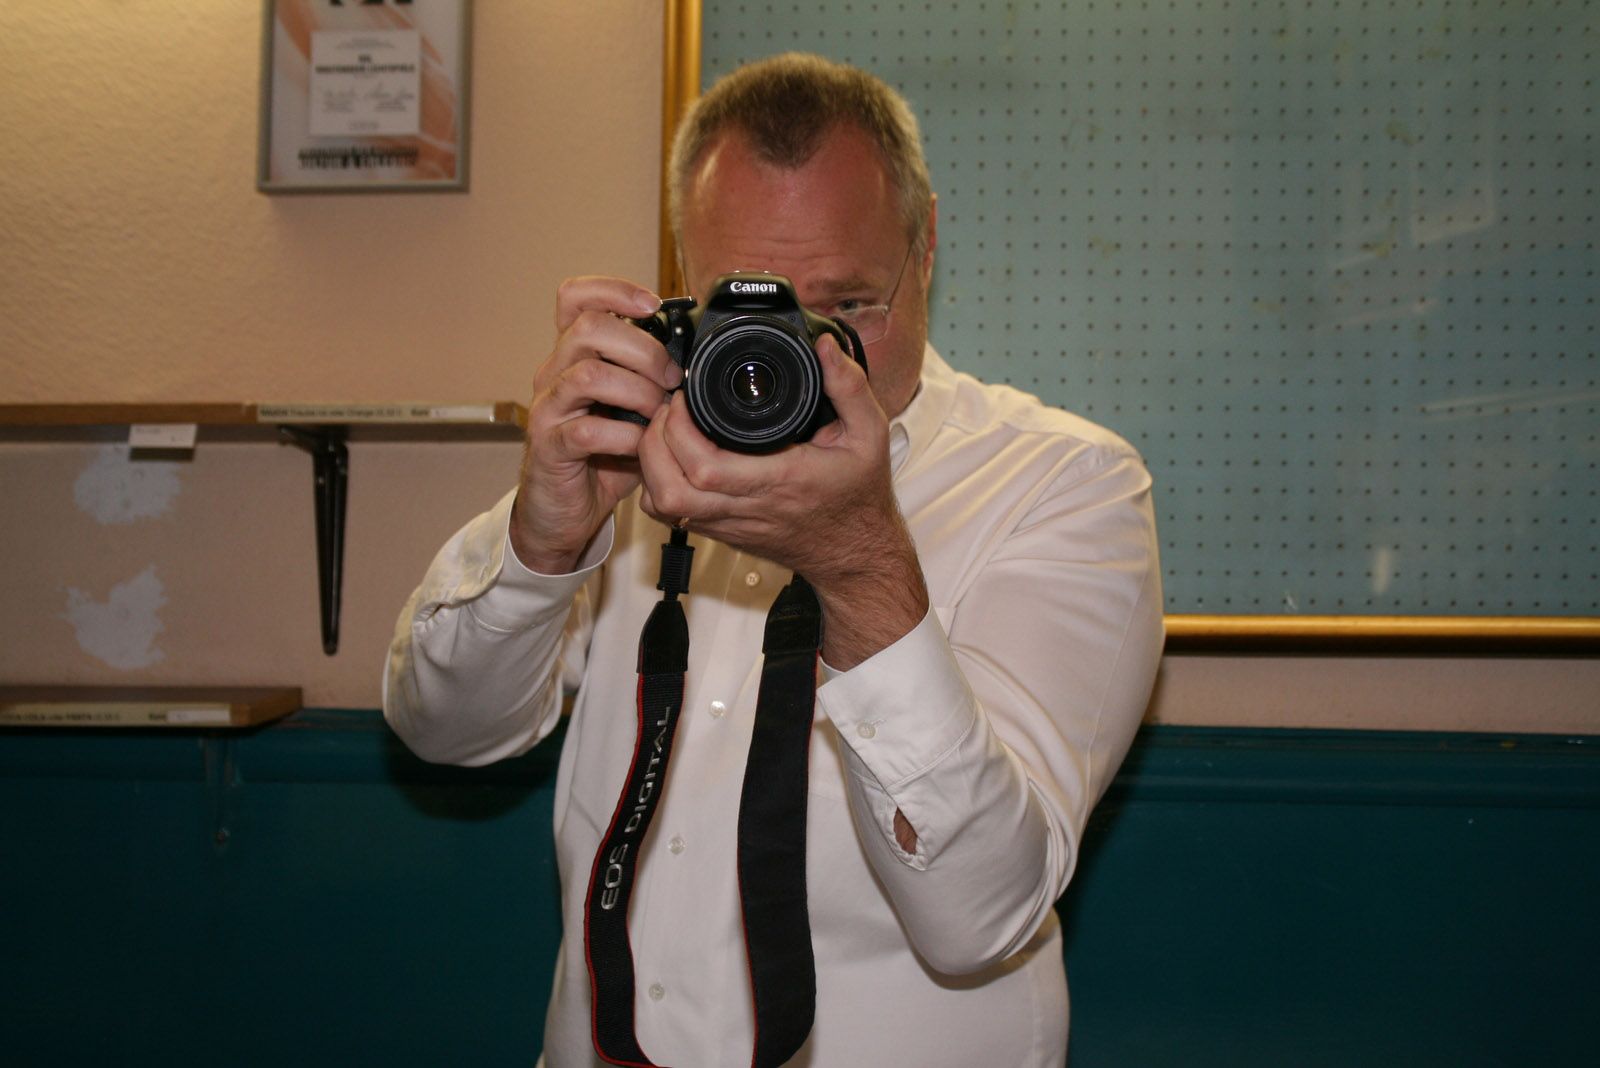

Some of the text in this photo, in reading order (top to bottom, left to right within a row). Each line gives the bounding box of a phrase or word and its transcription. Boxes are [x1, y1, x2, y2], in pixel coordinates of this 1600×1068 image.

[730, 281, 777, 293] Canon
[601, 706, 671, 910] EOS DIGITAL
